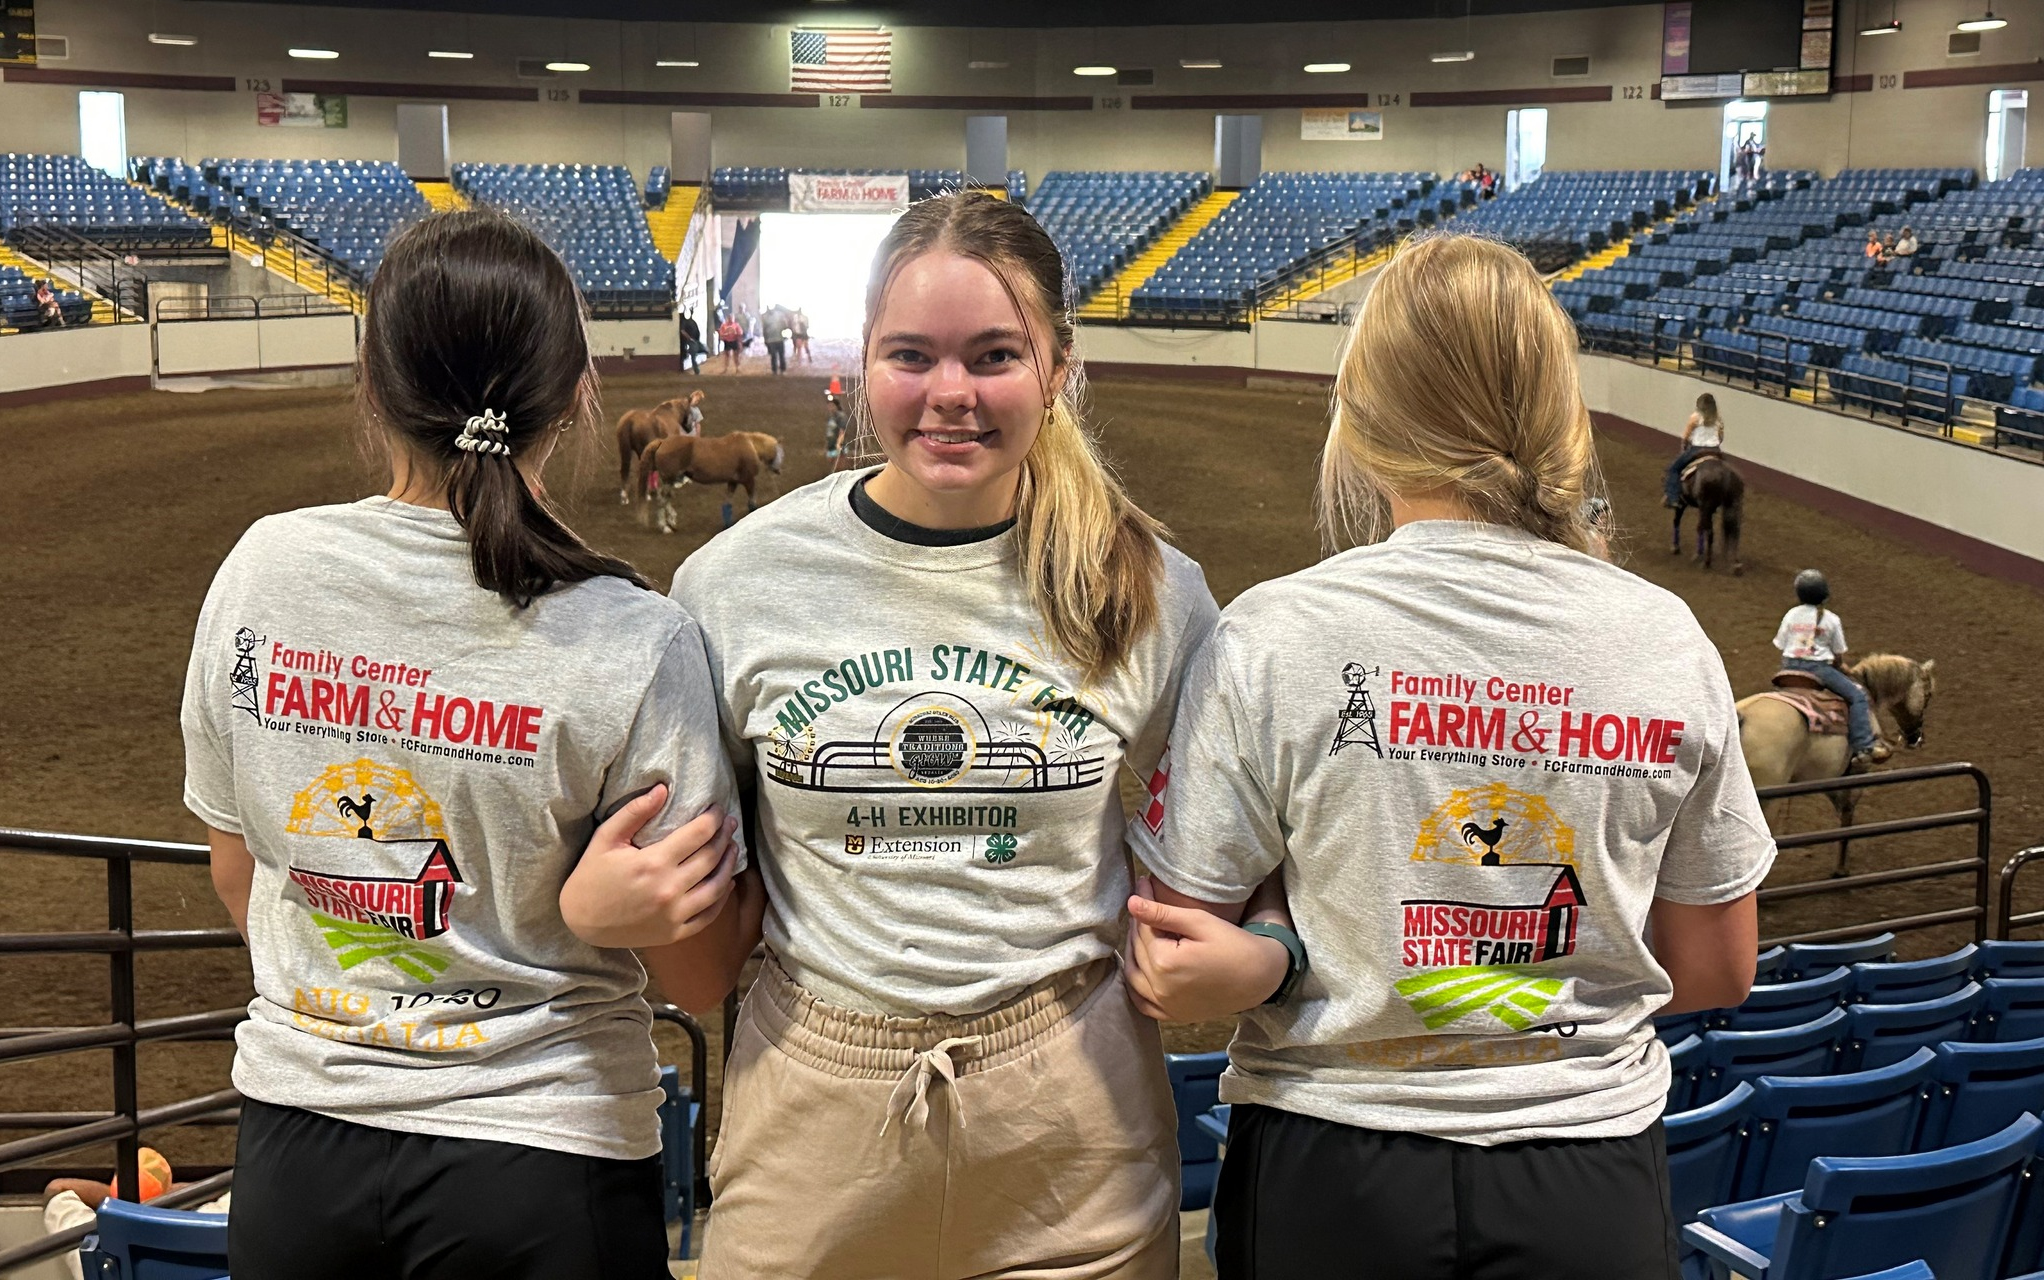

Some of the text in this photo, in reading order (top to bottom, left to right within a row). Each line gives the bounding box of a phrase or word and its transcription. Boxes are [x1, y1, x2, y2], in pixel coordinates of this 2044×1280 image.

[246, 80, 271, 92] 123
[829, 95, 850, 107] 127
[1623, 86, 1643, 99] 122
[817, 188, 848, 201] FARM
[862, 187, 898, 201] HOME
[271, 641, 432, 688] Family Center
[775, 644, 1095, 741] MISSOURI STATE FAIR
[1391, 670, 1574, 706] Family Center
[265, 671, 544, 752] FARM & HOME
[264, 717, 534, 768] Your Everything Store FCFarmandHome.com
[902, 743, 964, 751] TRADITIONS
[1389, 701, 1685, 764] FARM & HOME
[1389, 747, 1671, 779] Your Everything Store FCFarmandHome.com
[847, 806, 1017, 828] 4-H EXHIBITOR
[870, 835, 962, 853] Extension
[289, 870, 413, 915] MISSOURI
[304, 886, 370, 924] STATE
[1404, 906, 1535, 940] MISSOURI
[1402, 938, 1534, 967] STATE FAIR
[293, 987, 370, 1015] AUG
